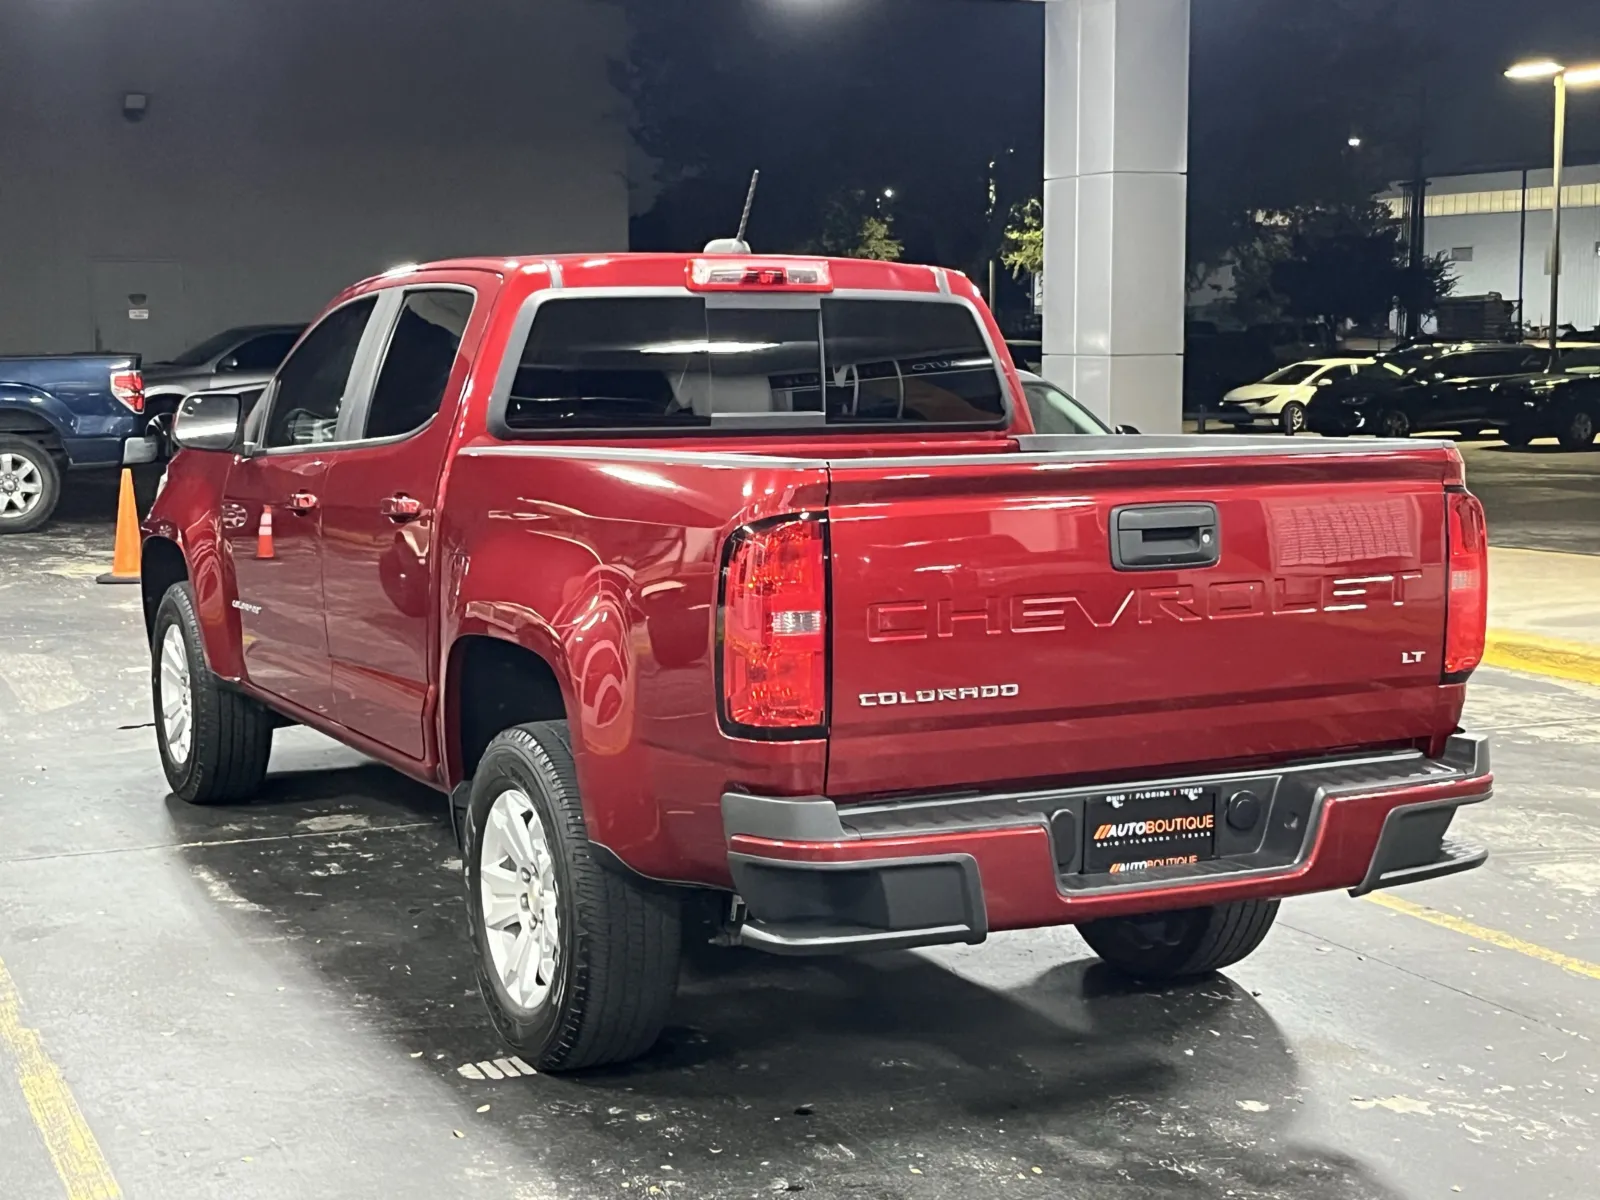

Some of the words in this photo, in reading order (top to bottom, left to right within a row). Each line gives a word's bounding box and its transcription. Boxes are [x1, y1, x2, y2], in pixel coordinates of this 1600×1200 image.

[867, 570, 1422, 643] CHEVROLET
[1402, 651, 1426, 664] LT
[858, 683, 1019, 706] COLORADO
